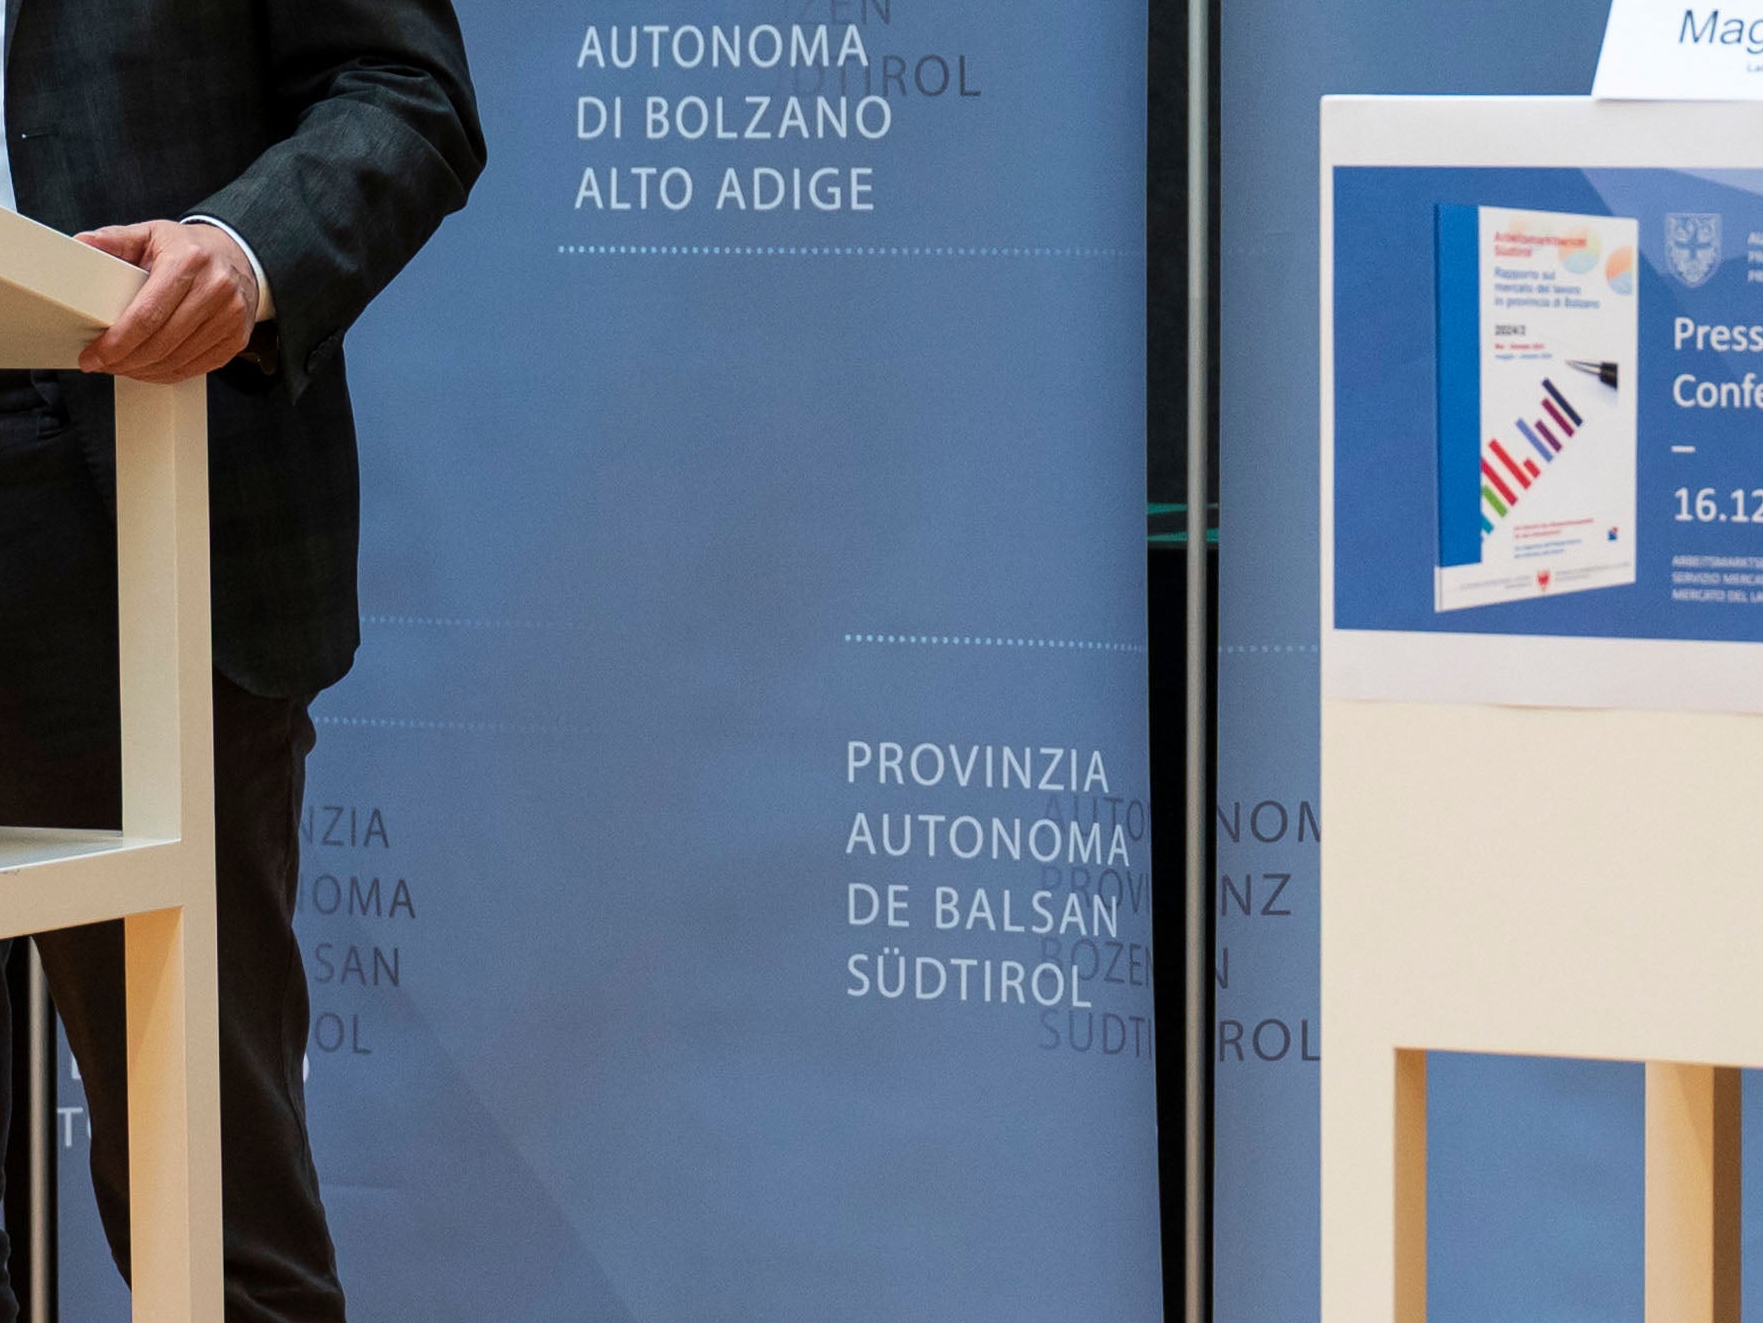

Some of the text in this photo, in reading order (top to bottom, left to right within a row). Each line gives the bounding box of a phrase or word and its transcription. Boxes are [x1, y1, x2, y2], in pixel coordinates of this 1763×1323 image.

[577, 23, 870, 69] AUTONOMA
[577, 95, 892, 139] DI BOLZANO
[575, 166, 875, 211] ALTO ADIGE
[848, 741, 1110, 793] PROVINZIA
[846, 812, 1130, 867] AUTONOMA
[849, 882, 1118, 937] DE BALSAN
[847, 947, 1092, 1007] SÜDTIROL
